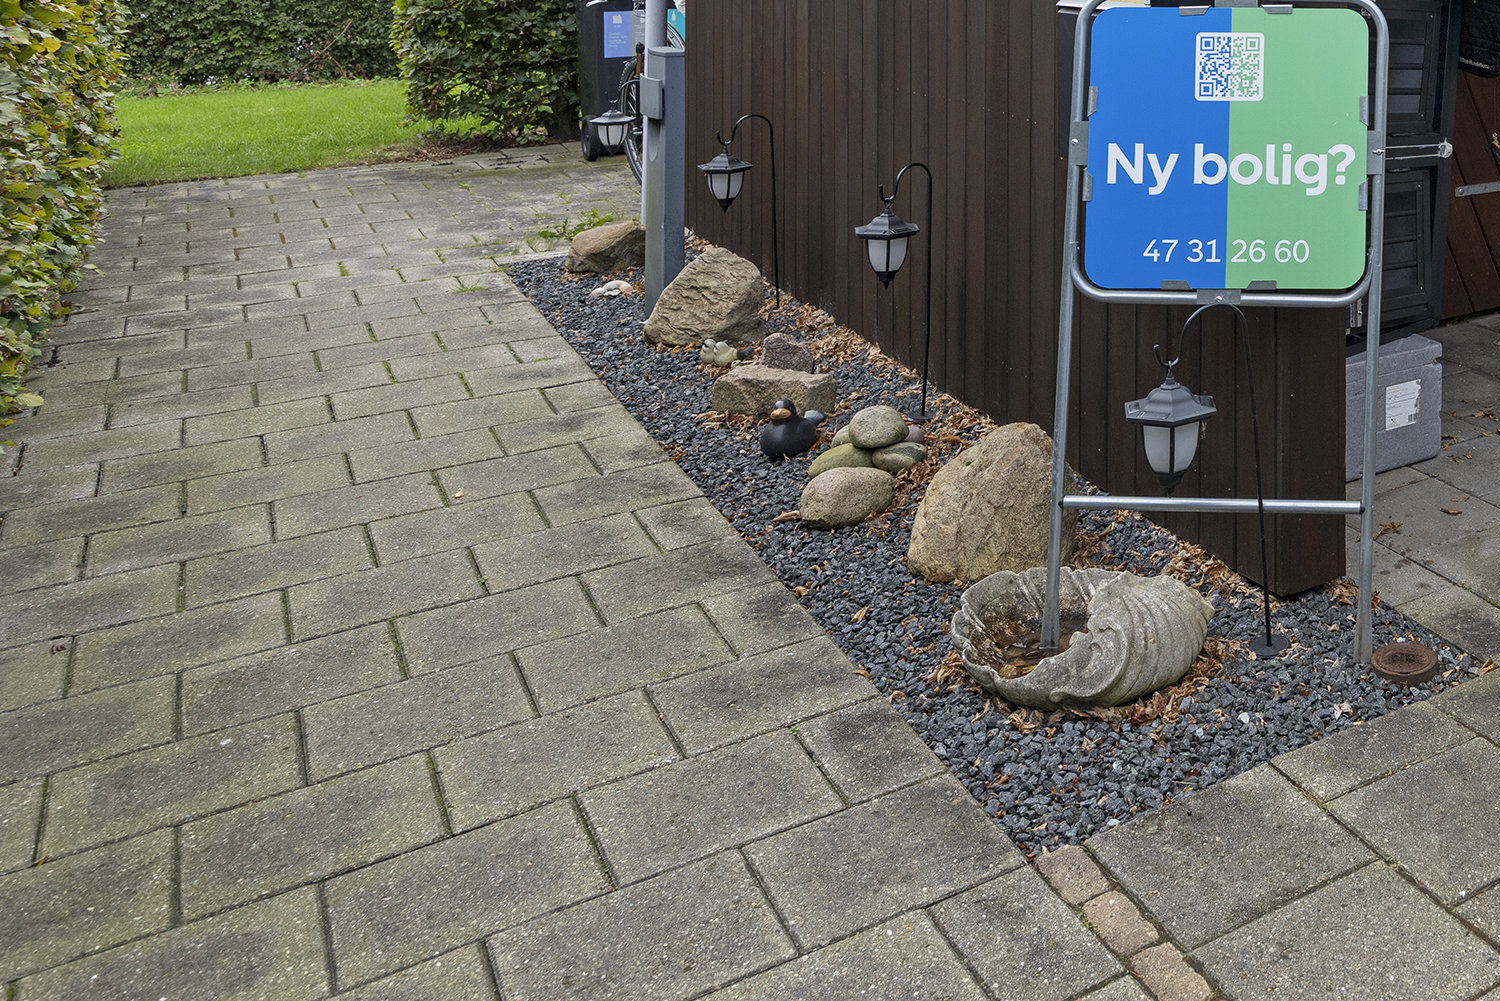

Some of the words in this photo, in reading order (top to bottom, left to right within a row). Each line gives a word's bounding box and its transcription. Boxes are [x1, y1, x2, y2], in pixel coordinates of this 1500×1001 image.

[1106, 143, 1179, 195] Ny
[1193, 143, 1355, 196] bolig?
[1143, 239, 1178, 262] 47
[1186, 239, 1221, 263] 31
[1230, 239, 1266, 263] 26
[1274, 239, 1310, 263] 60
